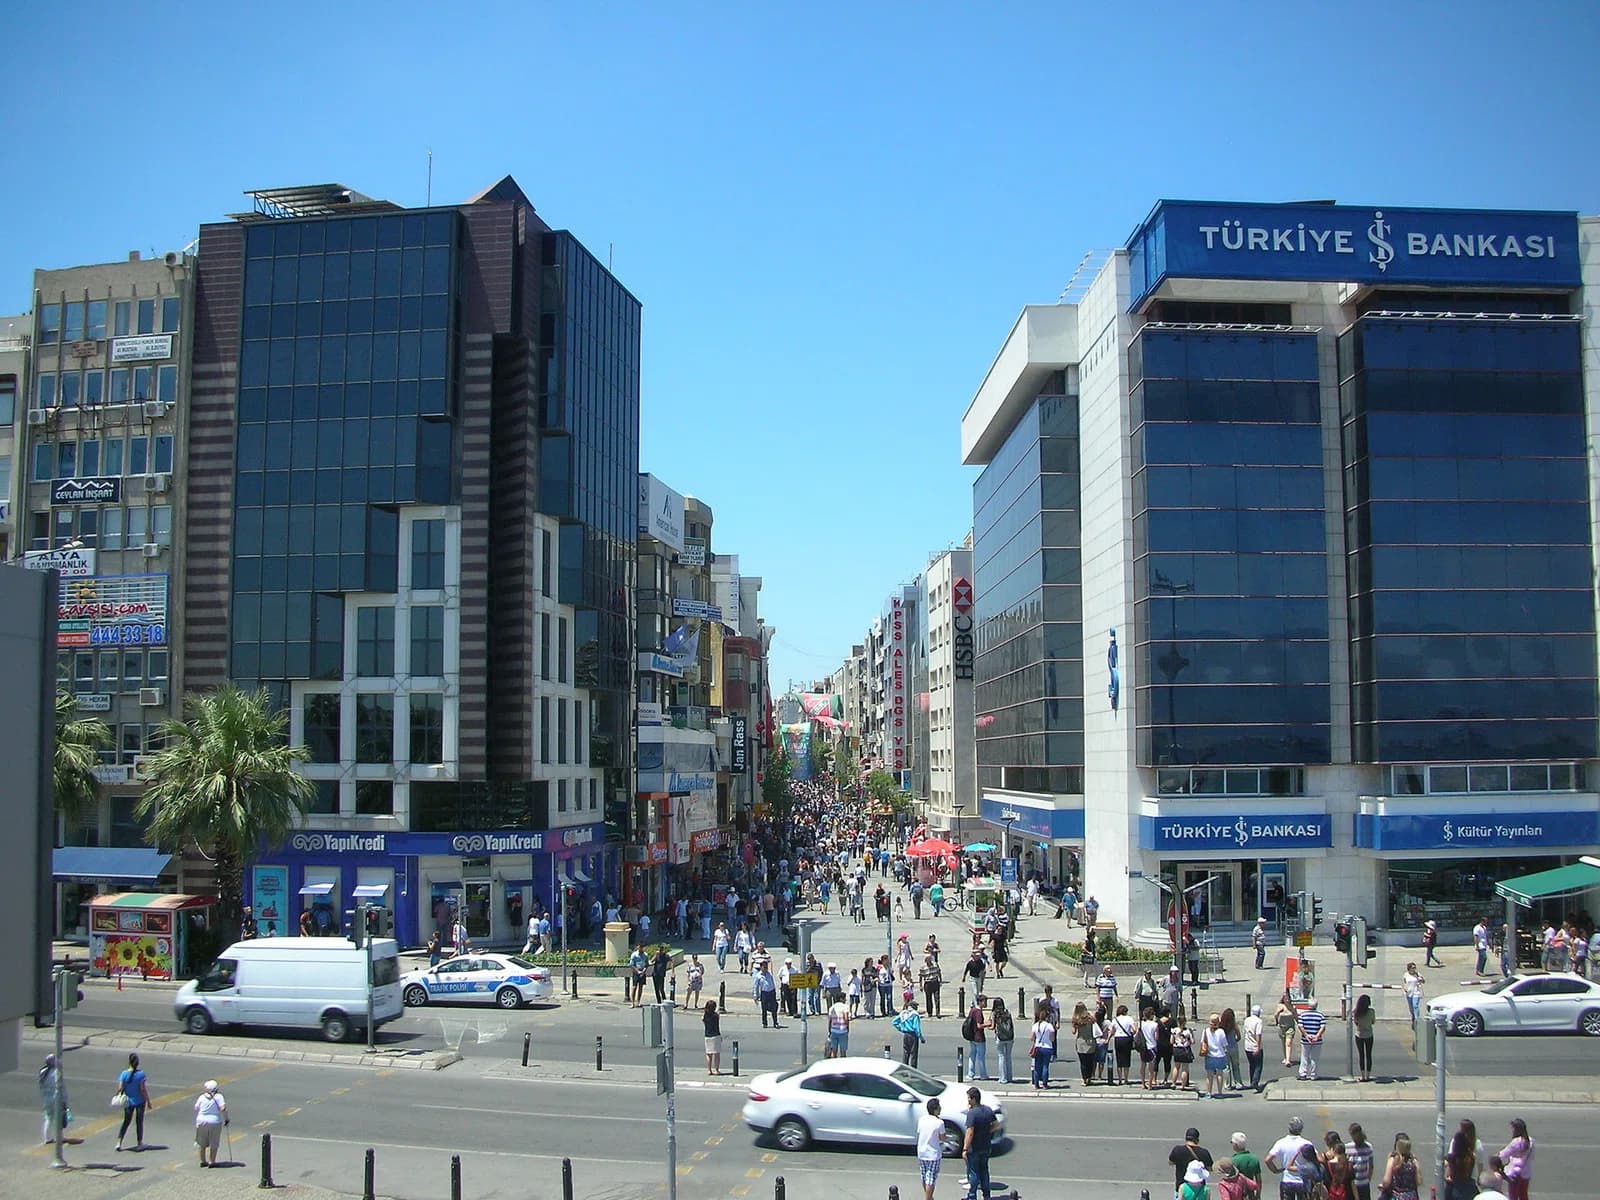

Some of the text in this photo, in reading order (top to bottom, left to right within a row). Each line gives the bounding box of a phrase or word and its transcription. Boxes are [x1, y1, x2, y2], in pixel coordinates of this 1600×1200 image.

[1199, 219, 1354, 253] TÜRKİYE
[1408, 232, 1555, 258] BANKASI
[55, 490, 83, 500] CEYLAN
[38, 551, 80, 560] ALYA
[92, 626, 120, 643] 444
[123, 624, 142, 643] 33
[145, 623, 163, 642] 18
[954, 615, 973, 681] HSBC
[733, 719, 744, 770] Jan Rass
[1161, 822, 1231, 840] TÜRKİYE
[1251, 824, 1321, 838] BANKASI
[1457, 825, 1492, 838] Kültür
[1494, 824, 1542, 840] Yayınları
[324, 834, 385, 852] YapıKredi
[485, 834, 542, 851] YapıKredi
